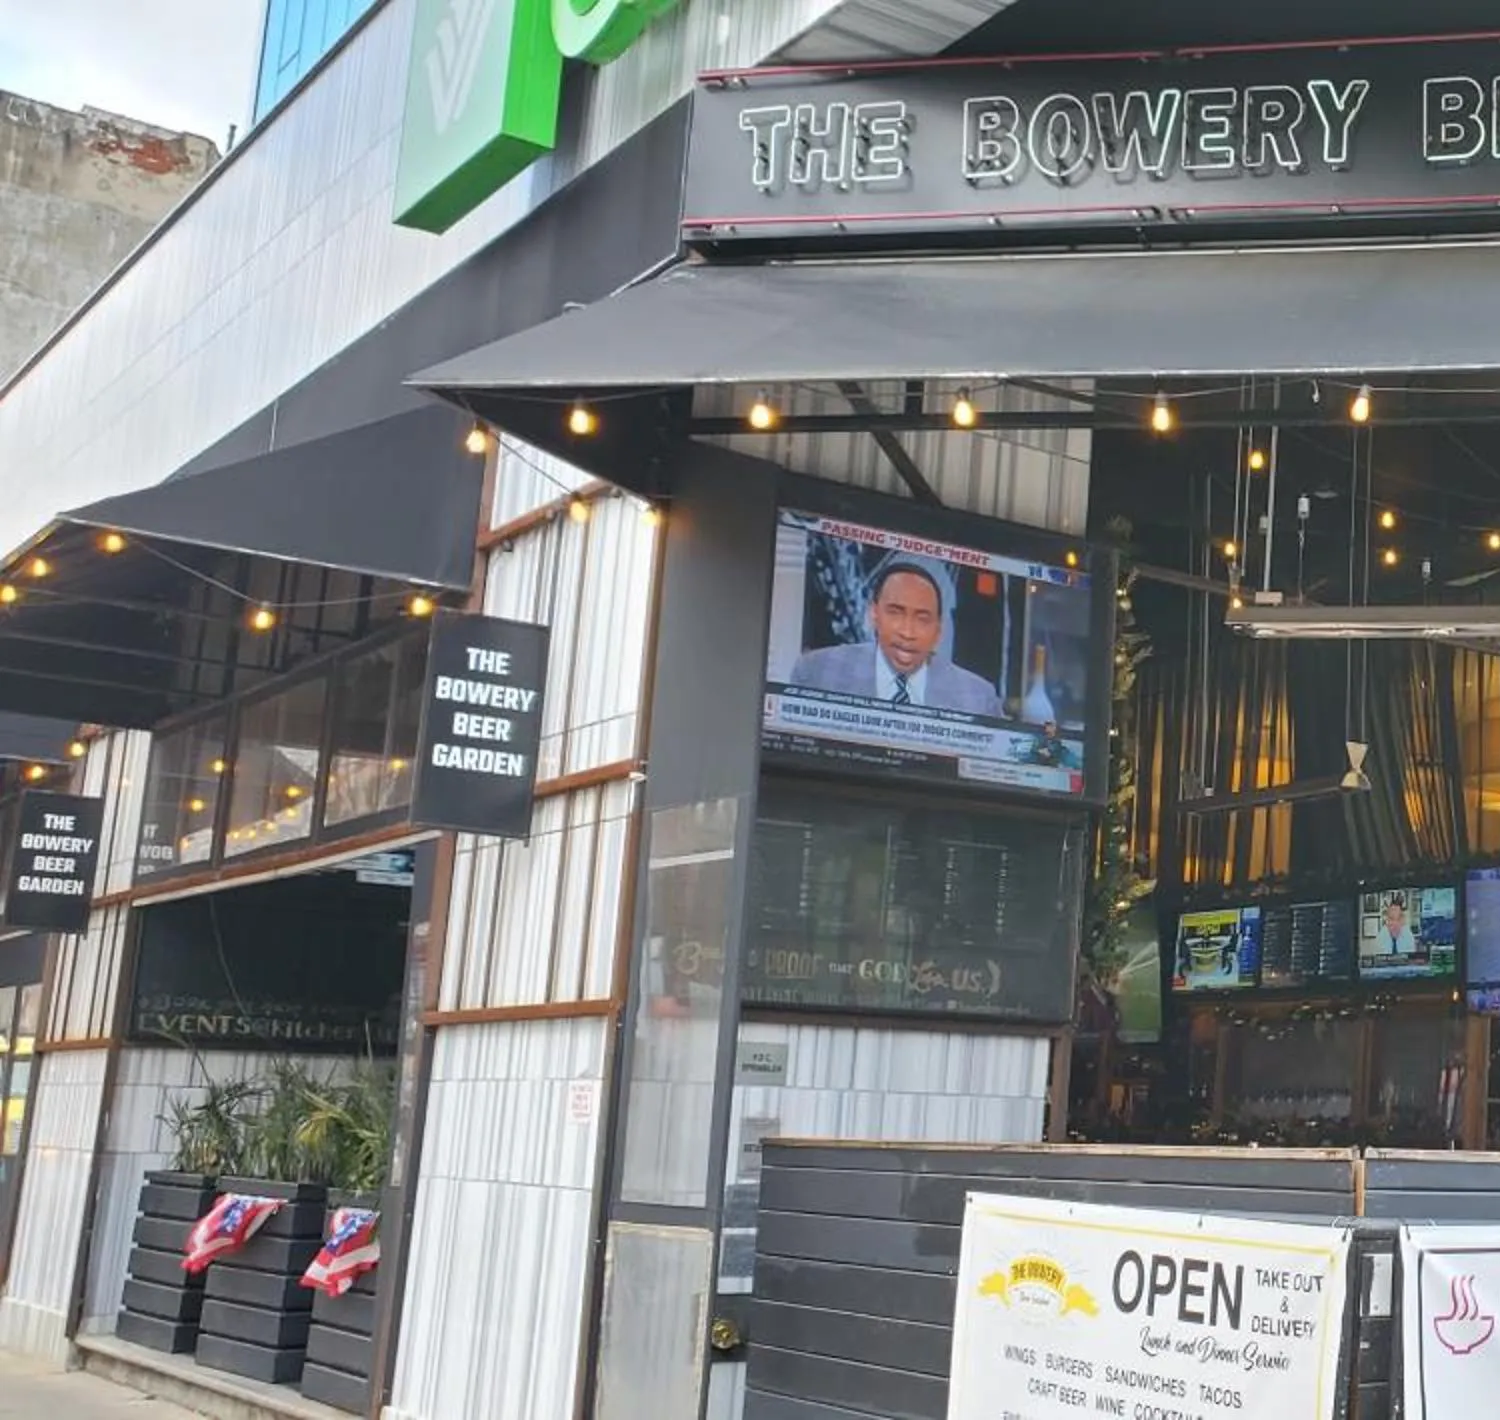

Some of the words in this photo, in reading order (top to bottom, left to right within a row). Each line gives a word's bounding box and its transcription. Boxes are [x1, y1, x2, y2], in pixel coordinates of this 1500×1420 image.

[740, 101, 906, 187] THE
[962, 80, 1370, 178] BOWERY
[821, 521, 886, 545] PASSING
[466, 647, 512, 675] THE
[436, 675, 537, 713] BOWERY
[452, 711, 512, 742] BEER
[432, 743, 525, 777] GARDEN
[43, 813, 76, 831] THE
[21, 832, 93, 854] BOWERY
[33, 855, 76, 873] BEER
[18, 875, 85, 896] GARDEN
[1112, 1249, 1245, 1331] OPEN
[1255, 1268, 1290, 1290] TAKE
[1293, 1273, 1324, 1293] OUT
[1280, 1295, 1290, 1313] &
[1252, 1315, 1316, 1339] DELIVERY
[1139, 1325, 1170, 1357] Lunch
[1175, 1334, 1197, 1355] and
[1199, 1335, 1240, 1364] Dinner
[1004, 1344, 1037, 1366] WINGS
[1045, 1352, 1093, 1380] BURGERS
[1105, 1365, 1187, 1398] SANDWICHES
[1199, 1382, 1243, 1410] TACOS
[1027, 1376, 1058, 1398] CRAFT
[1058, 1386, 1088, 1407] BEER
[1095, 1394, 1125, 1417] WINE
